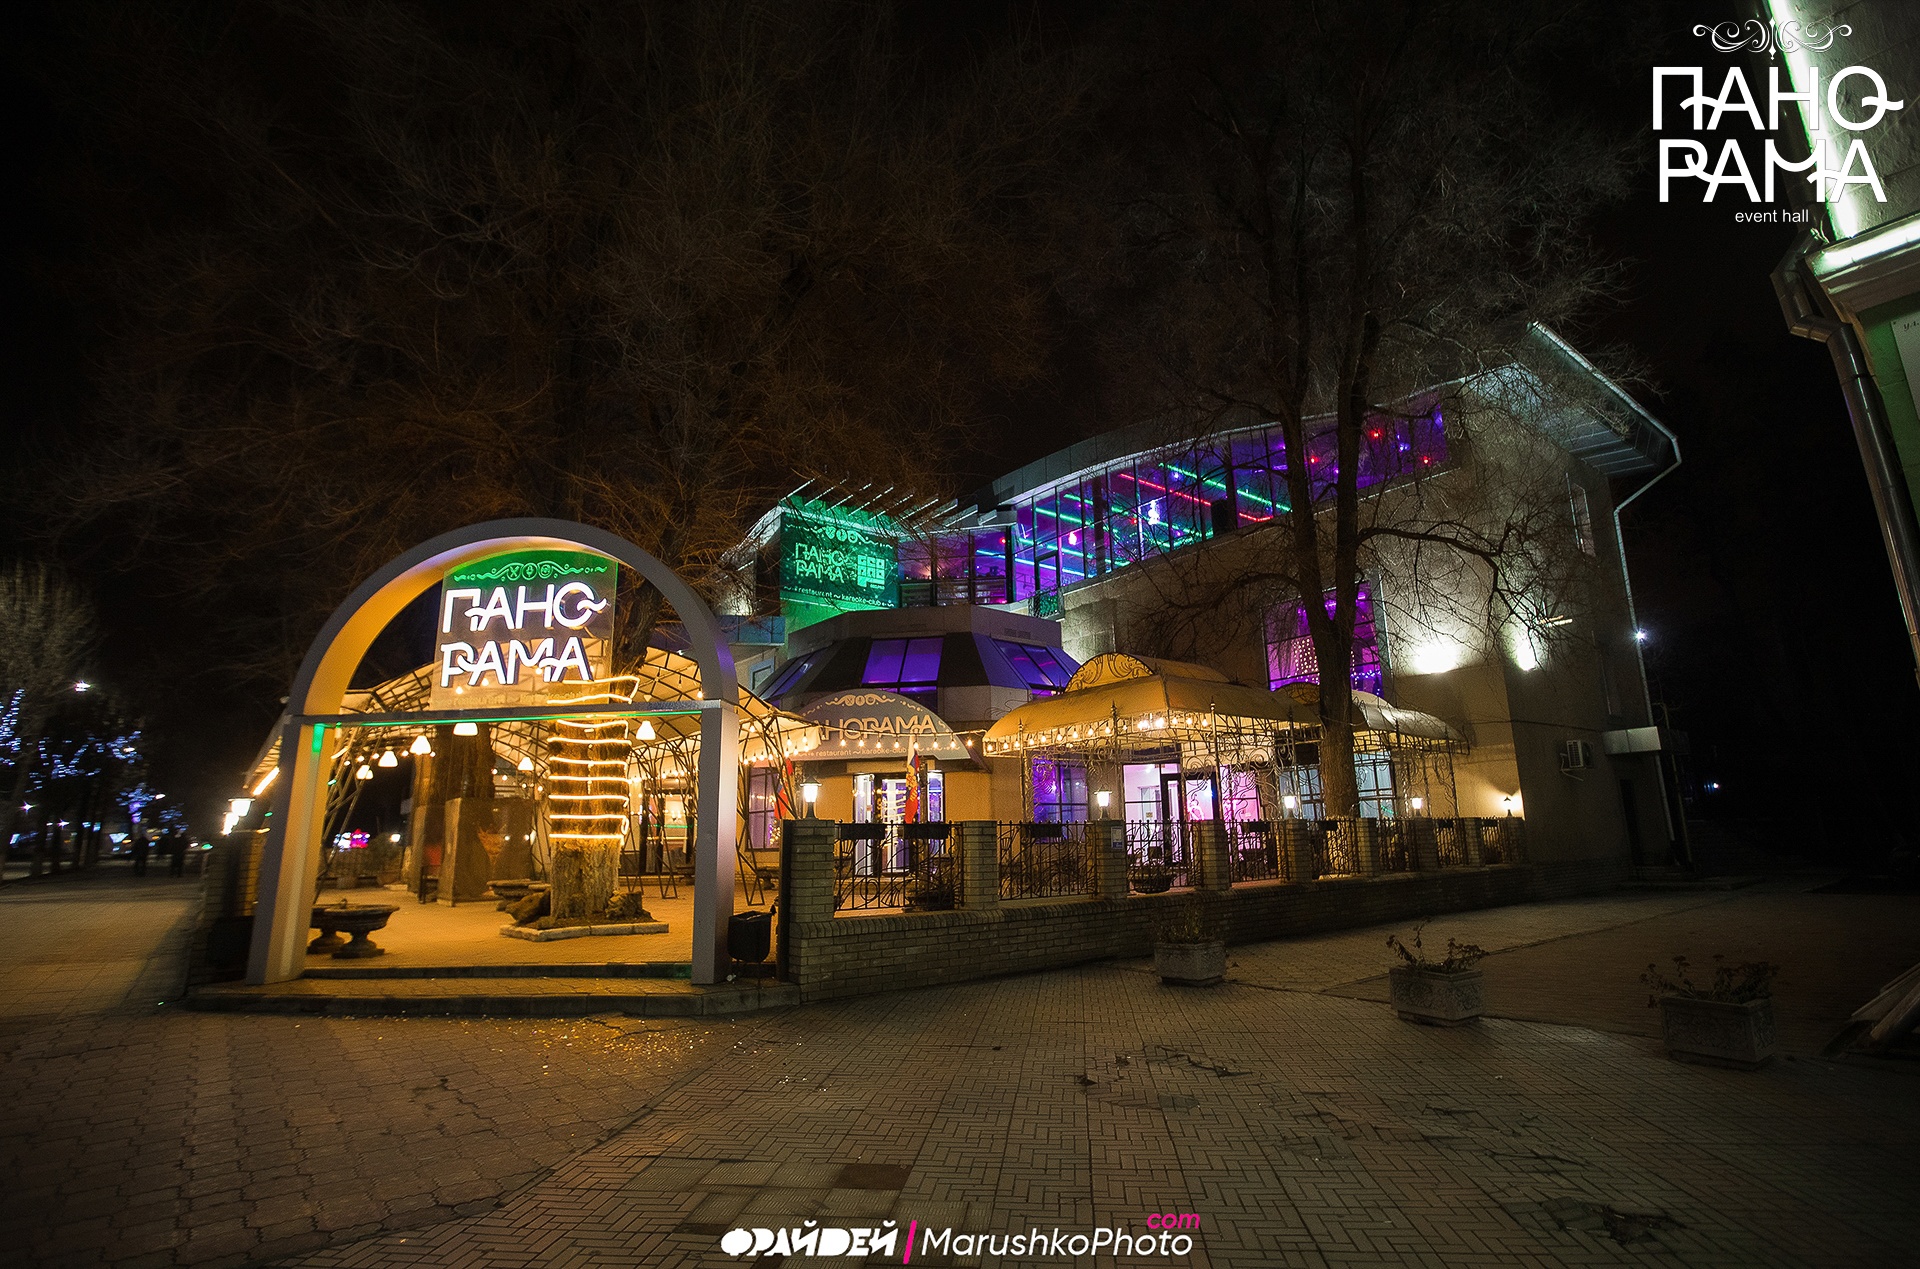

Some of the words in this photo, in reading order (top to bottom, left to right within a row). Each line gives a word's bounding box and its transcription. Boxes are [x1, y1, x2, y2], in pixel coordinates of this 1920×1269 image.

[795, 559, 845, 584] РАМА
[442, 581, 607, 634] ПАНО
[440, 636, 594, 688] РАМА
